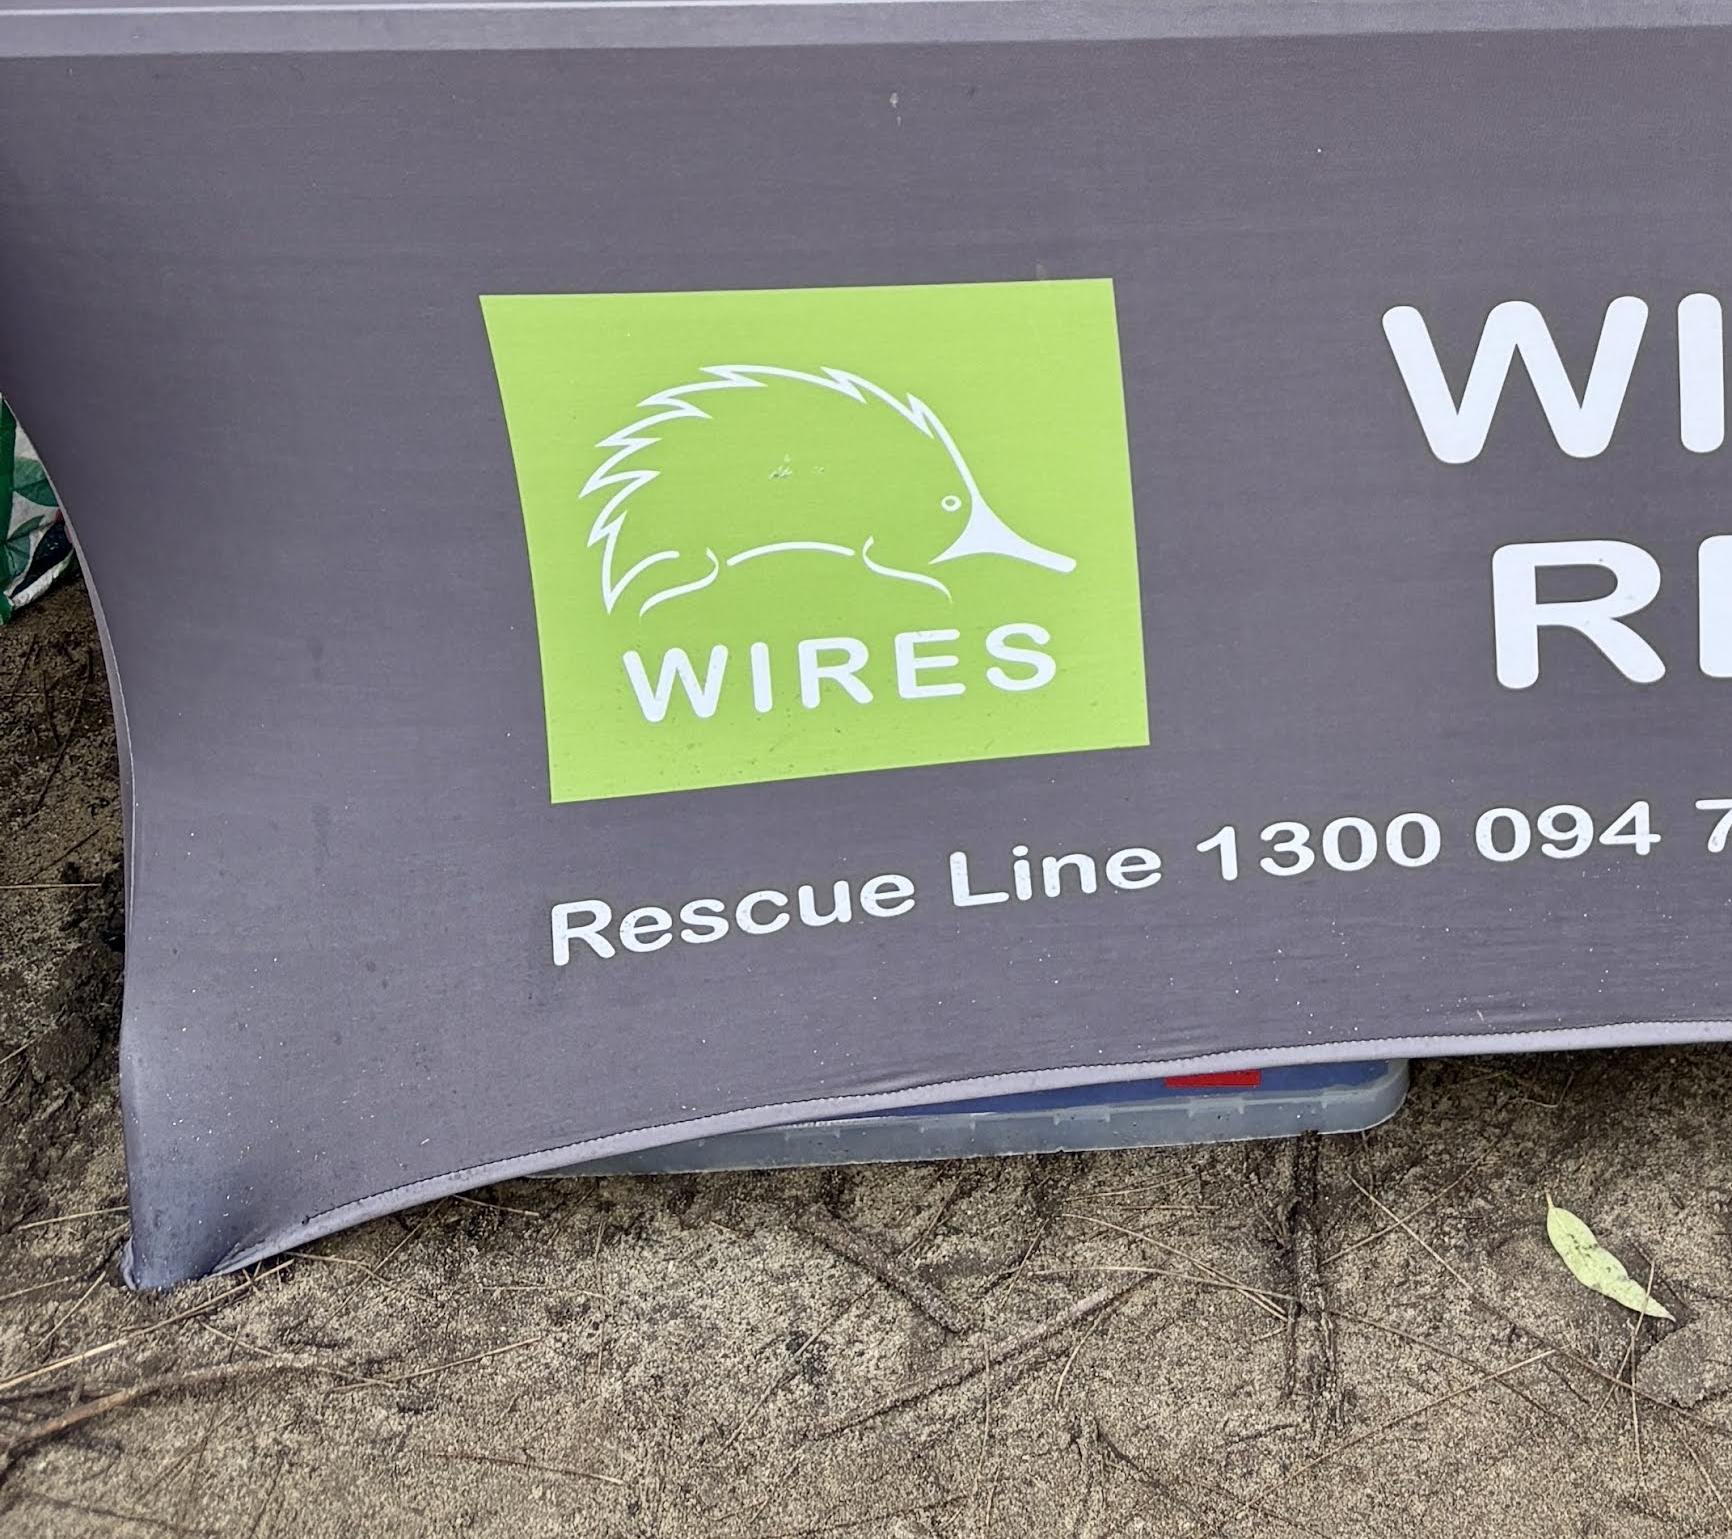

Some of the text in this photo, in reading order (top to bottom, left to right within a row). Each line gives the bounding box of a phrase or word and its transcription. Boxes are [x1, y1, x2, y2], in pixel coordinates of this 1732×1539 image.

[622, 623, 1056, 723] WIRES
[551, 874, 916, 967] Rescue
[949, 845, 1162, 907] Line
[1196, 812, 1441, 881] 1300
[1475, 800, 1662, 862] 094
